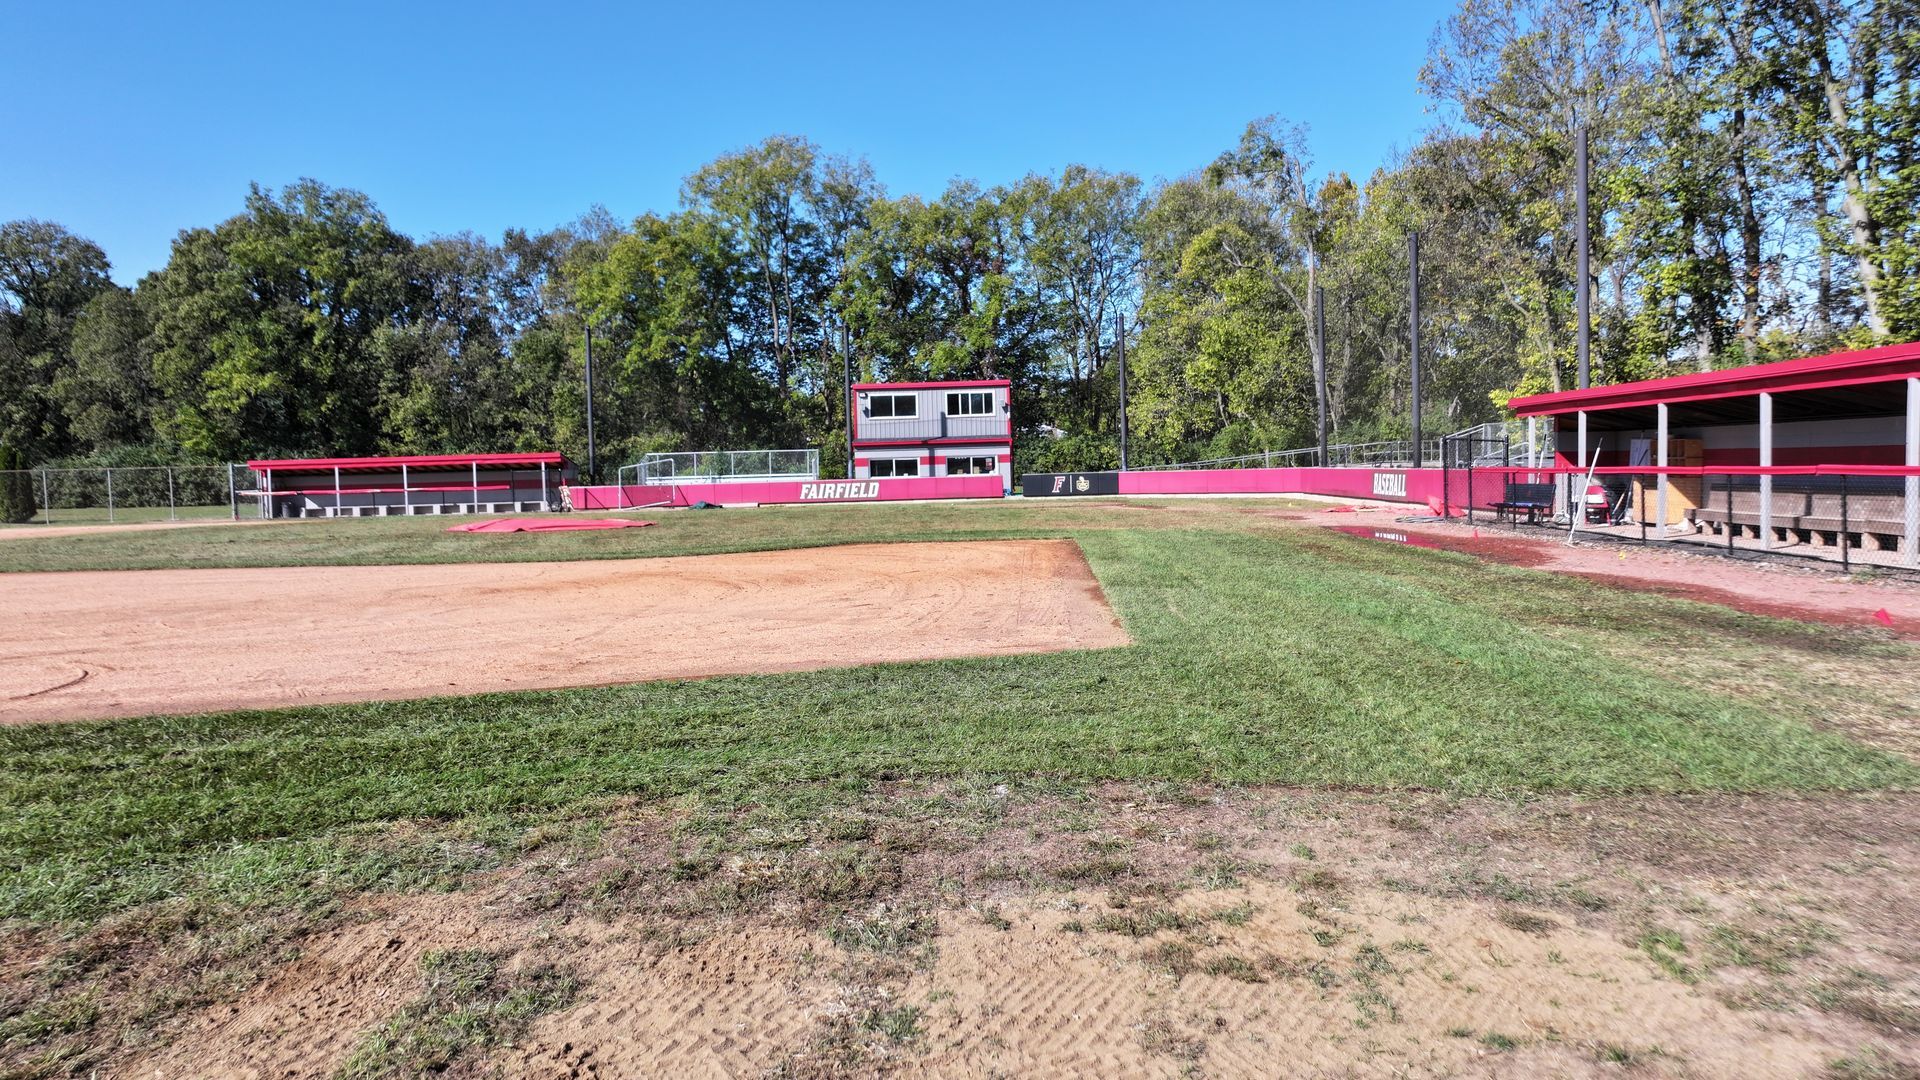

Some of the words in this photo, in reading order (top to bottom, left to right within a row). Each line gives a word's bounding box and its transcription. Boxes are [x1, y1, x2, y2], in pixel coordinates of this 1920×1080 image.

[800, 482, 880, 499] FAIRFIELD
[1051, 475, 1066, 493] F
[1373, 473, 1406, 496] BASEBALL
